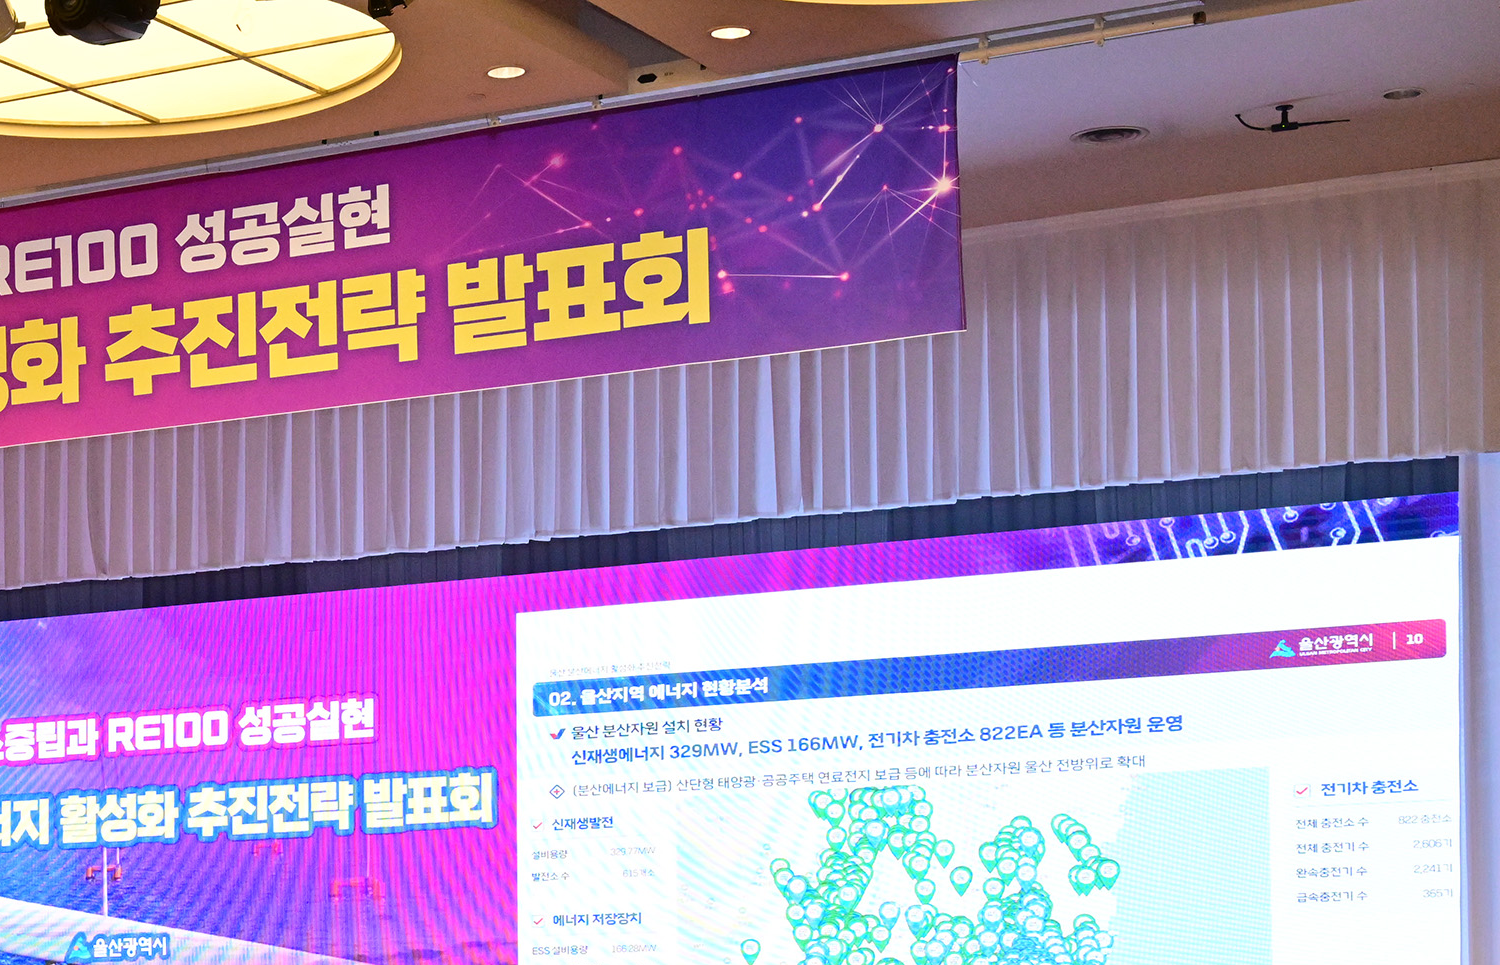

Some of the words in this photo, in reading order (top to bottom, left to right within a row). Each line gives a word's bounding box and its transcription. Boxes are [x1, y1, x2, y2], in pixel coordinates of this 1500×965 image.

[175, 183, 392, 274] 성공실현
[104, 273, 428, 397] 추진전략
[447, 226, 712, 356] 발표회
[1299, 633, 1374, 651] 울산광역시
[1406, 633, 1424, 645] 10
[549, 691, 577, 707] 02.
[581, 686, 645, 706] 울산지역
[649, 682, 698, 700] 에너지
[702, 677, 769, 696] 현황분석
[107, 710, 230, 753] RE100
[238, 698, 376, 745] 성공실현
[571, 726, 600, 740] 울산
[602, 721, 659, 738] 분산자원
[662, 719, 690, 735] 설치
[694, 717, 724, 732] 현황
[571, 745, 665, 765] 신재생에너지
[670, 742, 743, 759] 329MW,
[749, 739, 783, 754] ESS
[787, 734, 864, 752] 166MW,
[868, 731, 920, 749] 전기차
[923, 728, 976, 746] 충전소
[979, 724, 1044, 742] 822EA
[1047, 722, 1066, 739] 등
[1070, 717, 1142, 737] 분산자원
[1146, 714, 1184, 733] 운영
[572, 781, 639, 797] (분산에너지
[643, 779, 672, 793] 보급)
[676, 777, 715, 792] 산단형
[818, 769, 871, 785] 연료전지
[875, 767, 902, 781] 보급
[904, 766, 931, 779] 등에
[934, 764, 962, 778] 따라
[966, 761, 1021, 777] 분산자원
[1024, 759, 1053, 774] 울산
[1056, 756, 1114, 772] 전방위로
[1117, 754, 1146, 769] 확대
[1321, 781, 1369, 797] 전기차
[1371, 779, 1419, 795] 충전소
[60, 792, 179, 841] 활성화
[187, 779, 354, 835] 추진전략
[363, 771, 493, 829] 발표회
[552, 816, 614, 831] 신재생발전
[1296, 819, 1318, 830] 전체
[1320, 817, 1355, 829] 충전소
[1357, 817, 1370, 827] 수
[1296, 843, 1318, 854] 전체
[1321, 842, 1355, 853] 충전기
[1357, 841, 1370, 851] 수
[561, 872, 570, 881] 수
[1356, 866, 1368, 876] 수
[1357, 891, 1368, 901] 수
[552, 914, 590, 927] 에너지
[592, 912, 642, 926] 저장장치
[93, 936, 167, 958] 울산광역시
[532, 946, 551, 956] ESS
